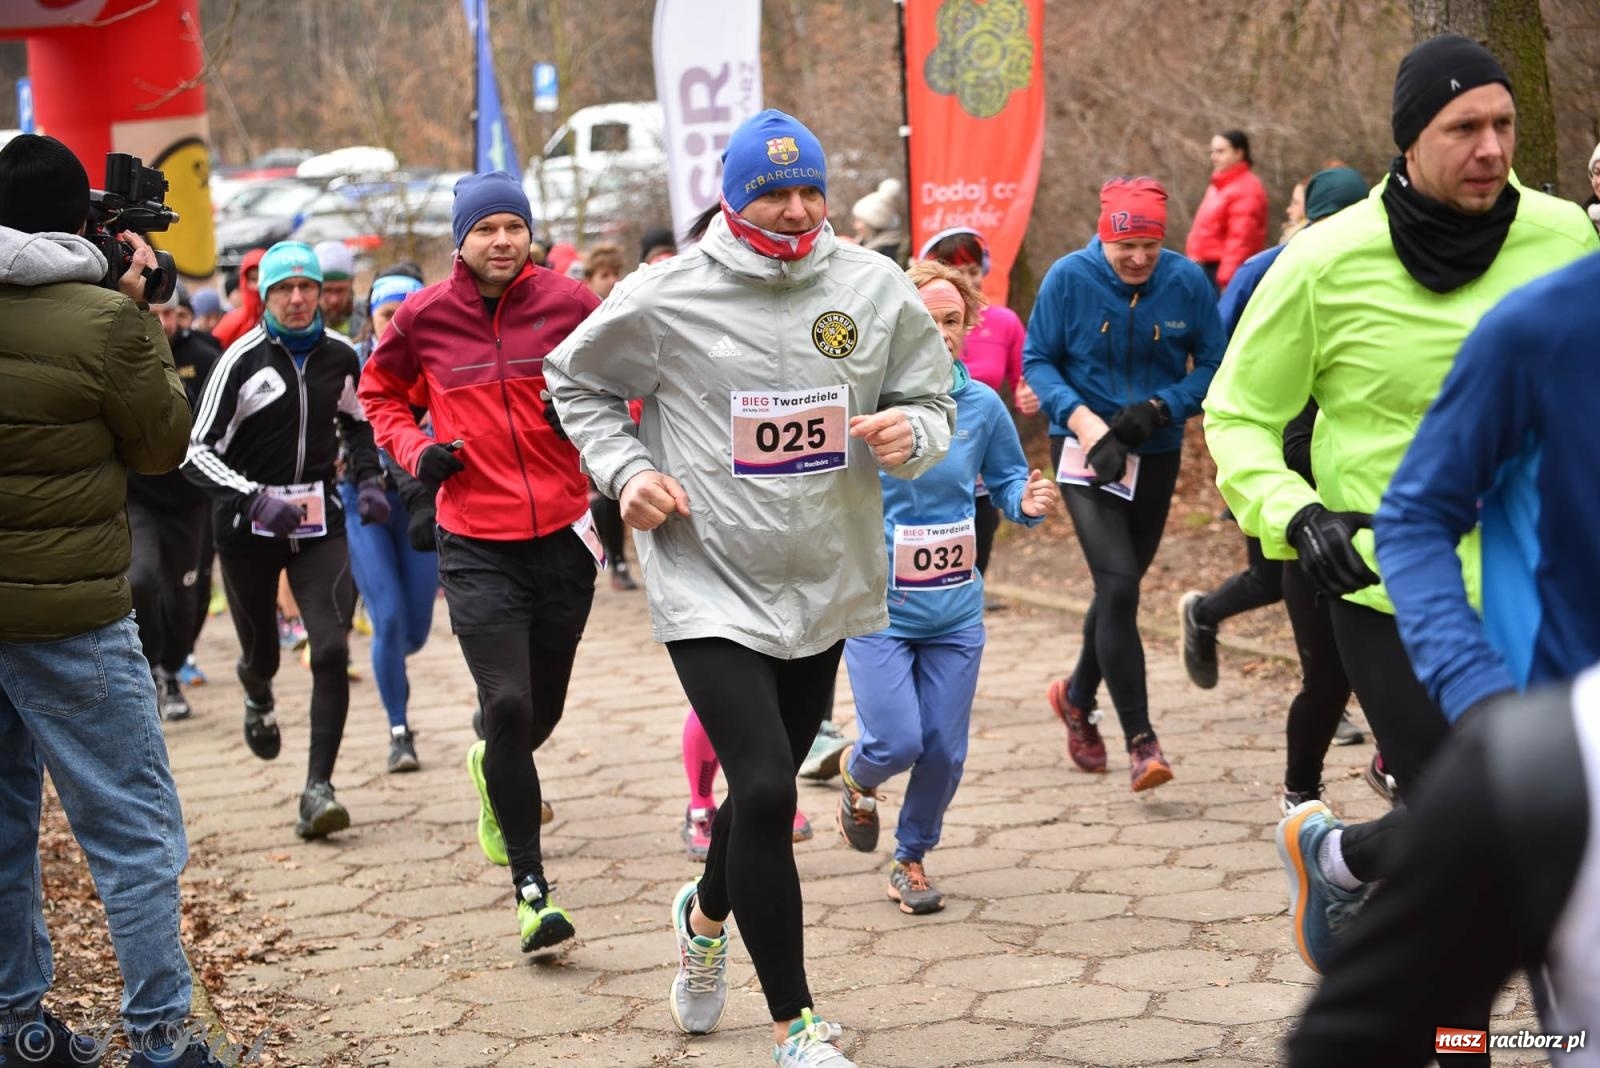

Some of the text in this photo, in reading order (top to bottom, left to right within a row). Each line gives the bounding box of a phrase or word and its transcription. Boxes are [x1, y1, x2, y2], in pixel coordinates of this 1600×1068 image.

[1111, 211, 1129, 233] 12
[816, 315, 853, 334] COLUMBUS
[708, 350, 742, 358] adidas
[819, 340, 842, 355] CREW
[742, 391, 838, 407] BIEG Twardziela
[756, 417, 826, 453] 025
[903, 524, 970, 537] BIEG Twardziela
[913, 544, 964, 571] 032
